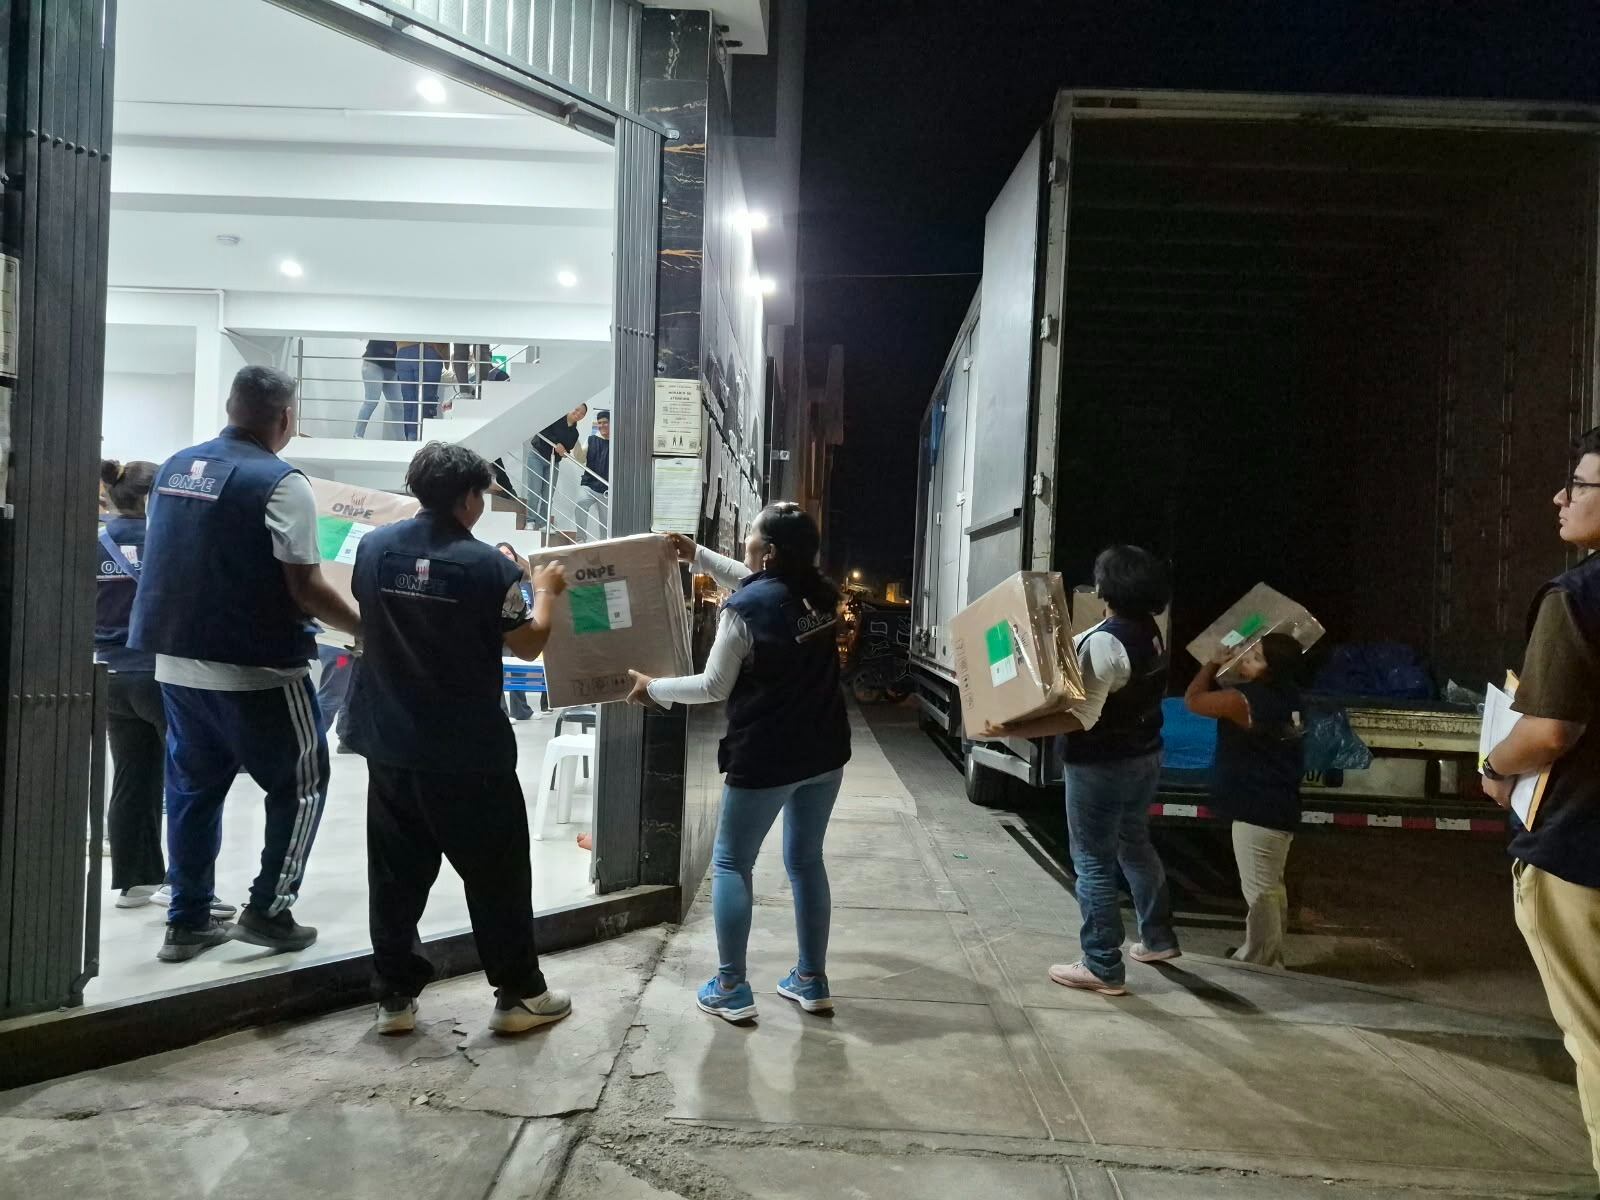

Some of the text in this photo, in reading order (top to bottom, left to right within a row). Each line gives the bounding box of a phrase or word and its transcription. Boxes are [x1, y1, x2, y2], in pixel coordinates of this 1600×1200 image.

[168, 473, 215, 493] ONPE
[332, 502, 374, 519] ONPE
[575, 564, 616, 581] ONPE
